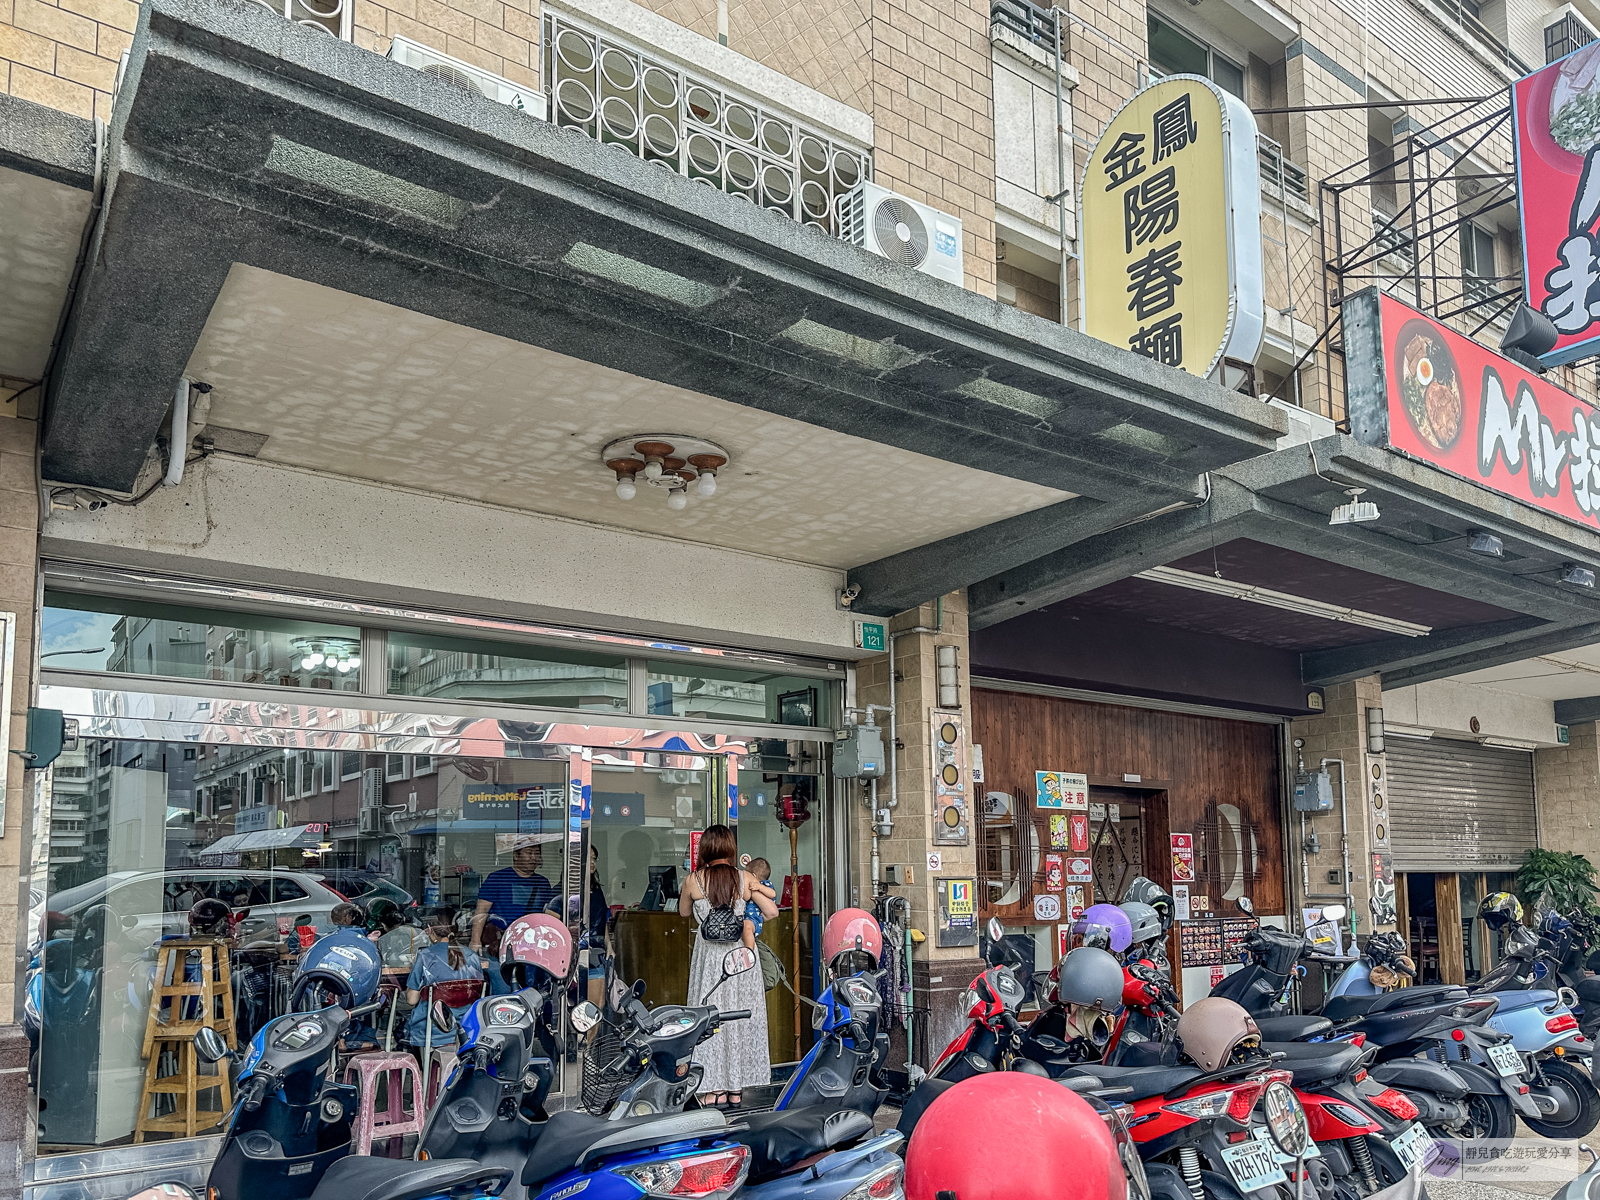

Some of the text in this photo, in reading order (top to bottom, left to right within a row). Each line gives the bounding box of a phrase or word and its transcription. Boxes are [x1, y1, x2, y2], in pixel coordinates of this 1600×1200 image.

[867, 635, 880, 646] 121
[1064, 791, 1085, 805] 注意
[677, 1116, 716, 1131] KYMCO
